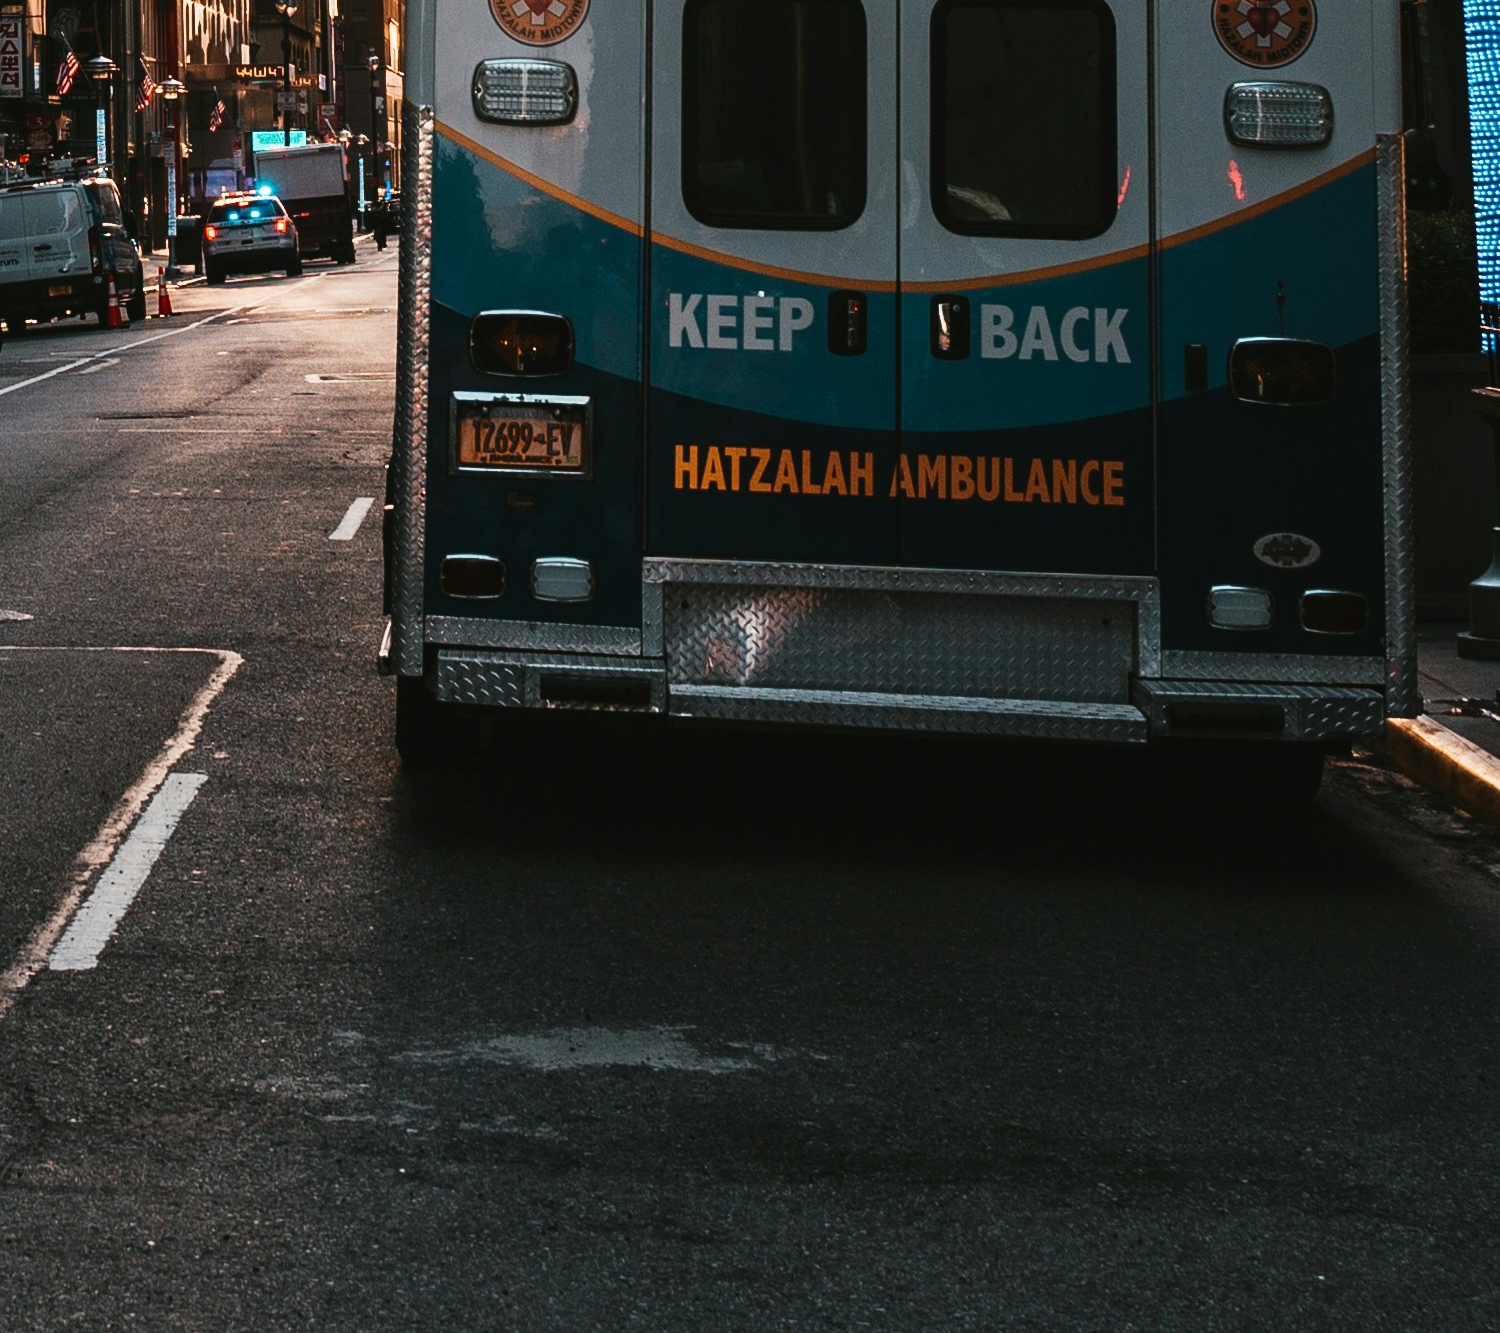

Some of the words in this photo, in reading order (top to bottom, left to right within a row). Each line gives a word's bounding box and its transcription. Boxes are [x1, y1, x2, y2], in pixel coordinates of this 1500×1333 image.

[541, 0, 583, 39] MIDTOWN
[1219, 18, 1262, 61] HAZALAH
[1267, 21, 1310, 62] MIDTOWN
[667, 292, 816, 352] KEEP
[980, 302, 1132, 364] BACK
[673, 444, 874, 499] HATZALAH
[888, 452, 1126, 509] AMBULANCE
